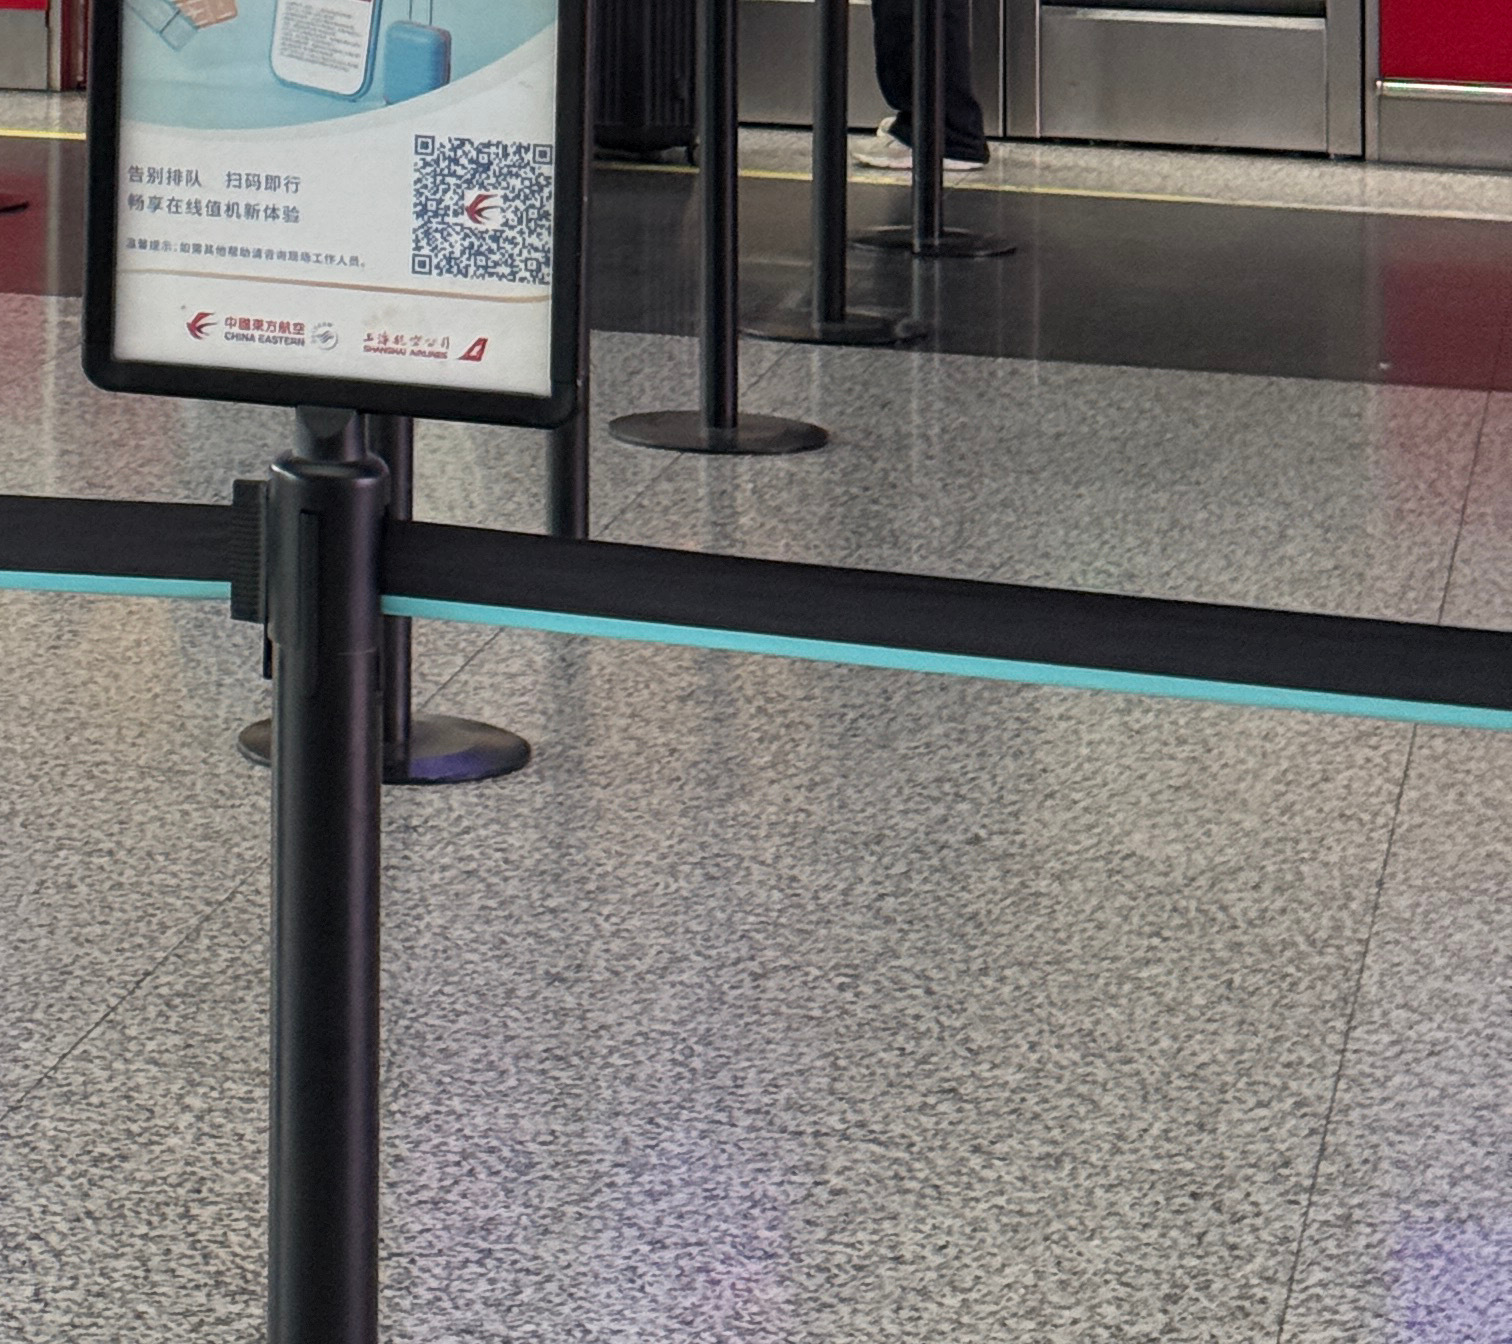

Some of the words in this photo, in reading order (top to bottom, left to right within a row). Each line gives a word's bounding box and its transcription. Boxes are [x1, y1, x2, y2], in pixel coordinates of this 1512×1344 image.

[127, 164, 202, 188] 告别排队
[225, 170, 301, 194] 扫码即行
[127, 193, 301, 224] 畅享在线值机新体验
[224, 332, 256, 344] CHINA
[258, 334, 306, 347] EASTERN
